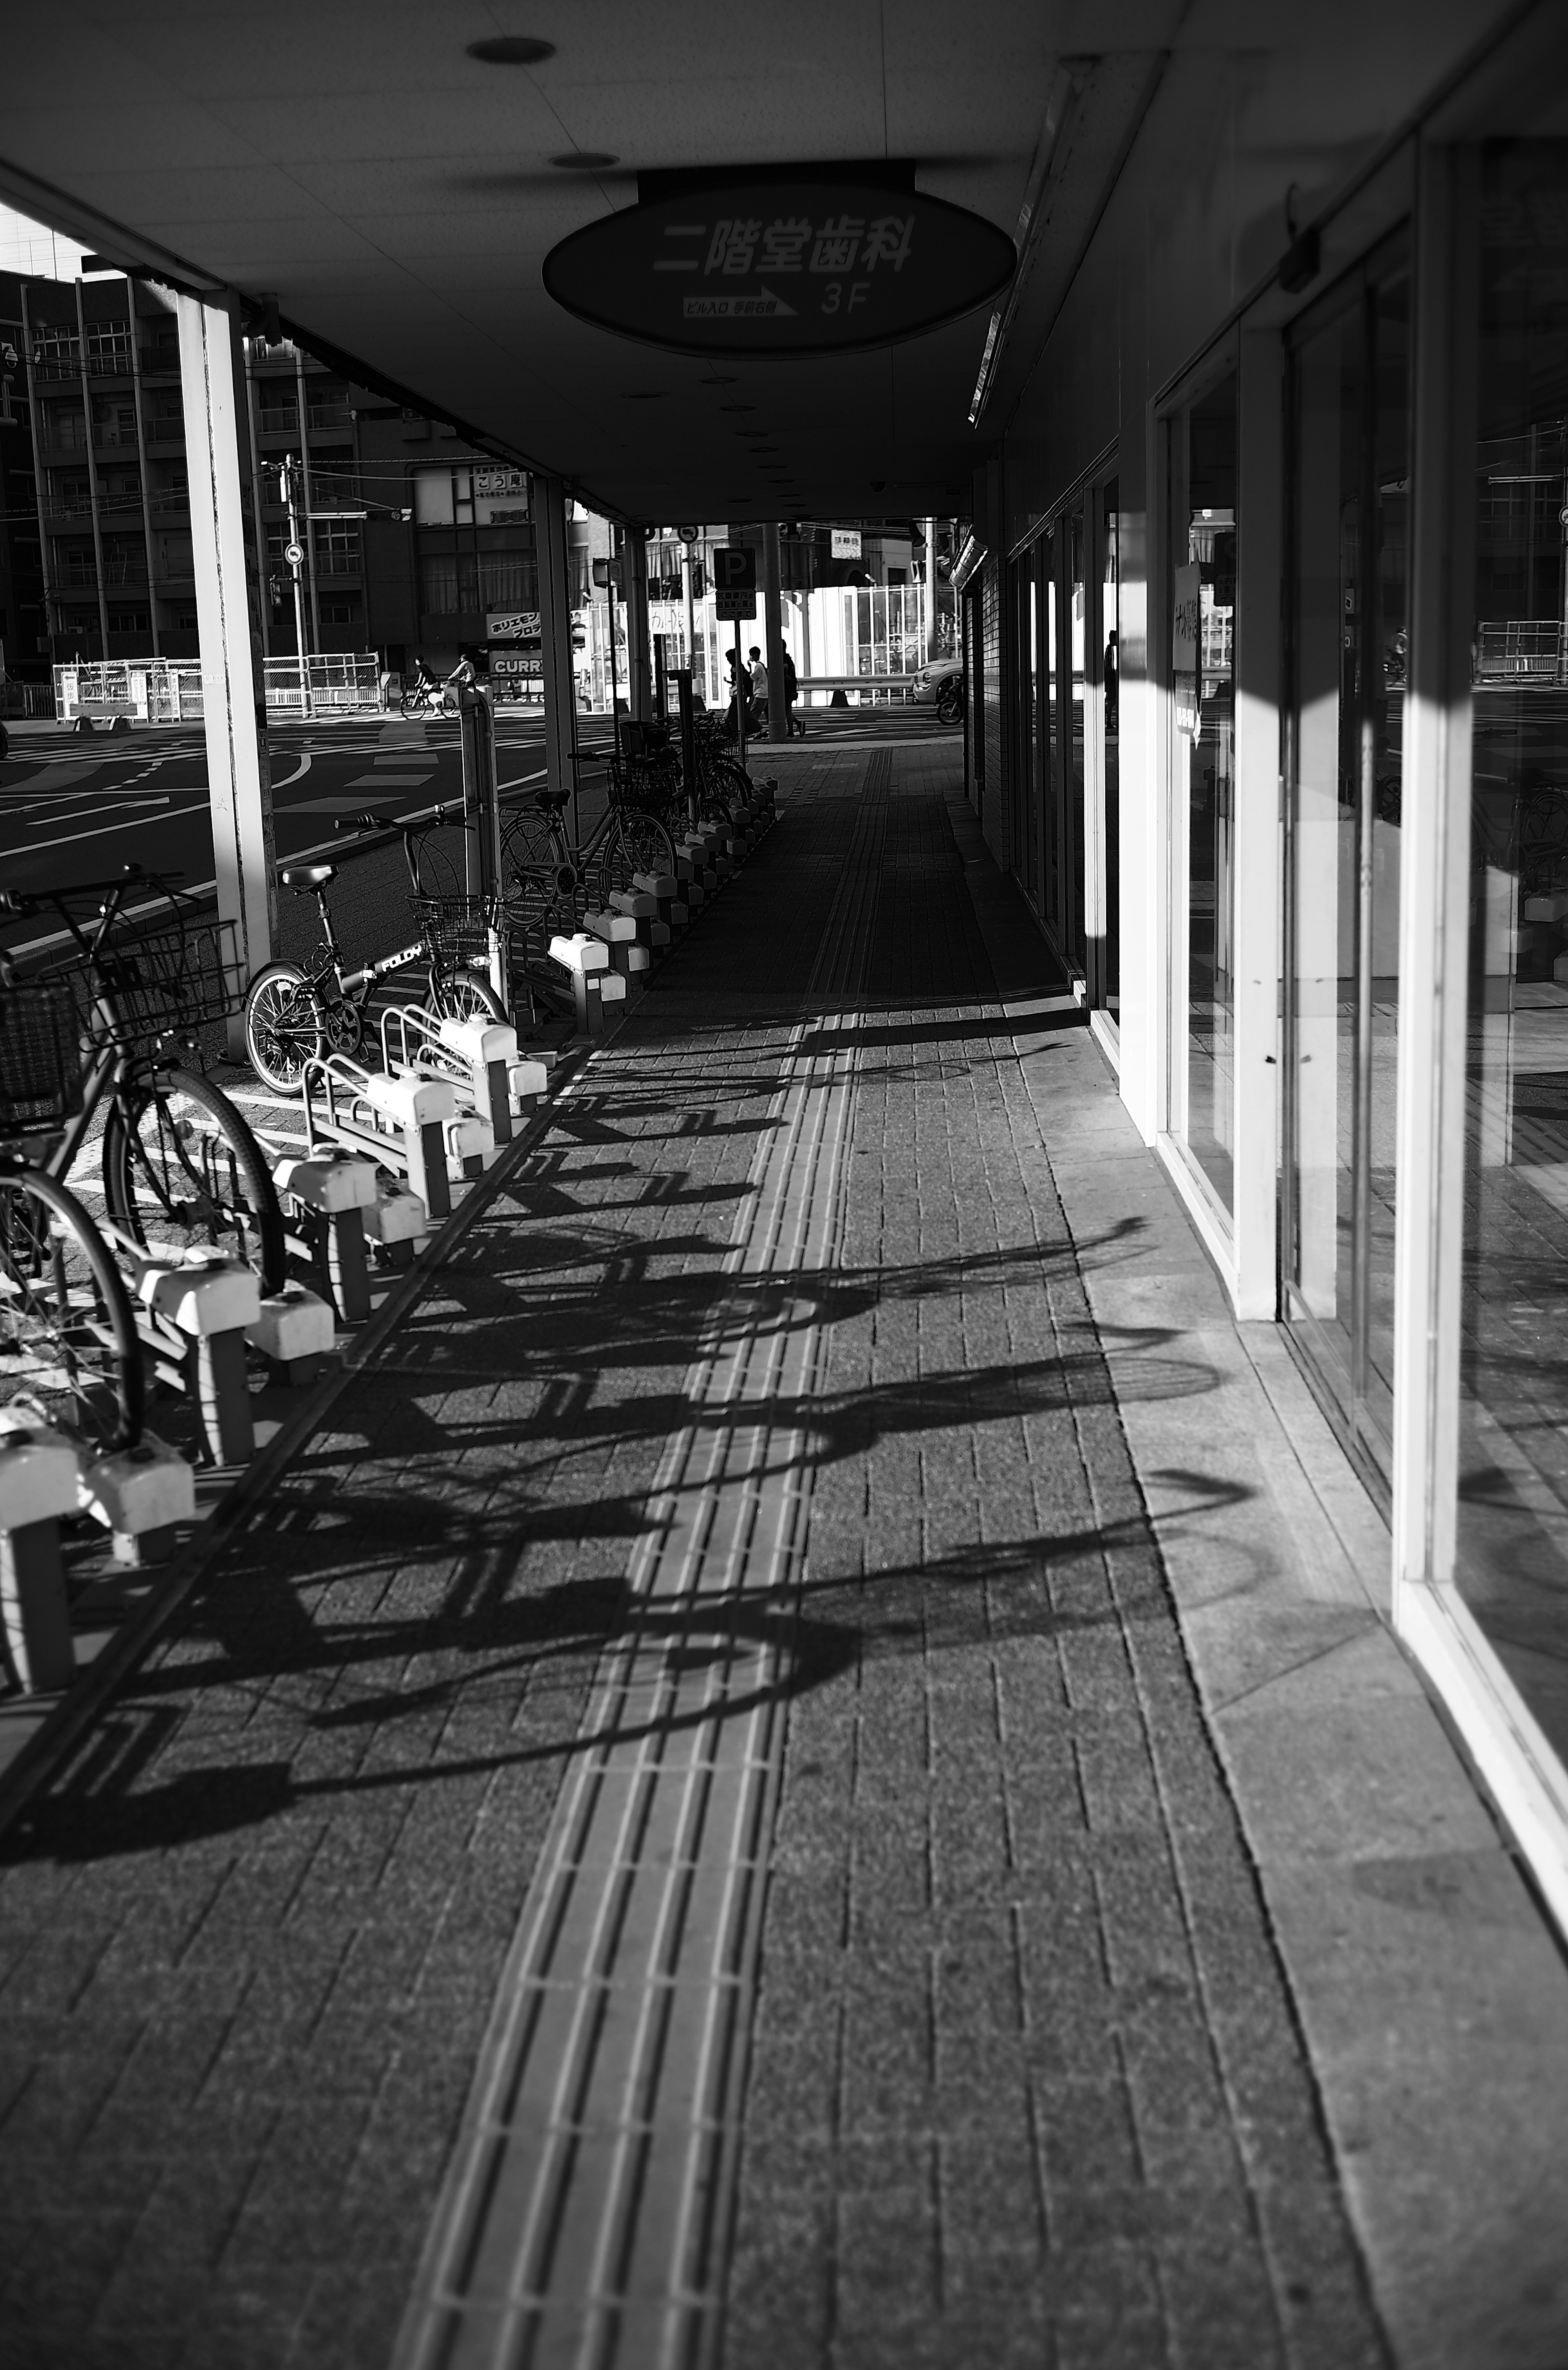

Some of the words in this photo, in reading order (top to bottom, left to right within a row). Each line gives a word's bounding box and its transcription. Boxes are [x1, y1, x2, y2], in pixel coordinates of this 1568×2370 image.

[653, 215, 915, 275] 二階堂歯科
[687, 301, 728, 314] ビル入口
[734, 301, 777, 314] 手前右側
[821, 283, 871, 314] 3F
[724, 552, 747, 585] P
[492, 613, 537, 632] ホリエモン
[381, 944, 422, 972] FOLDY
